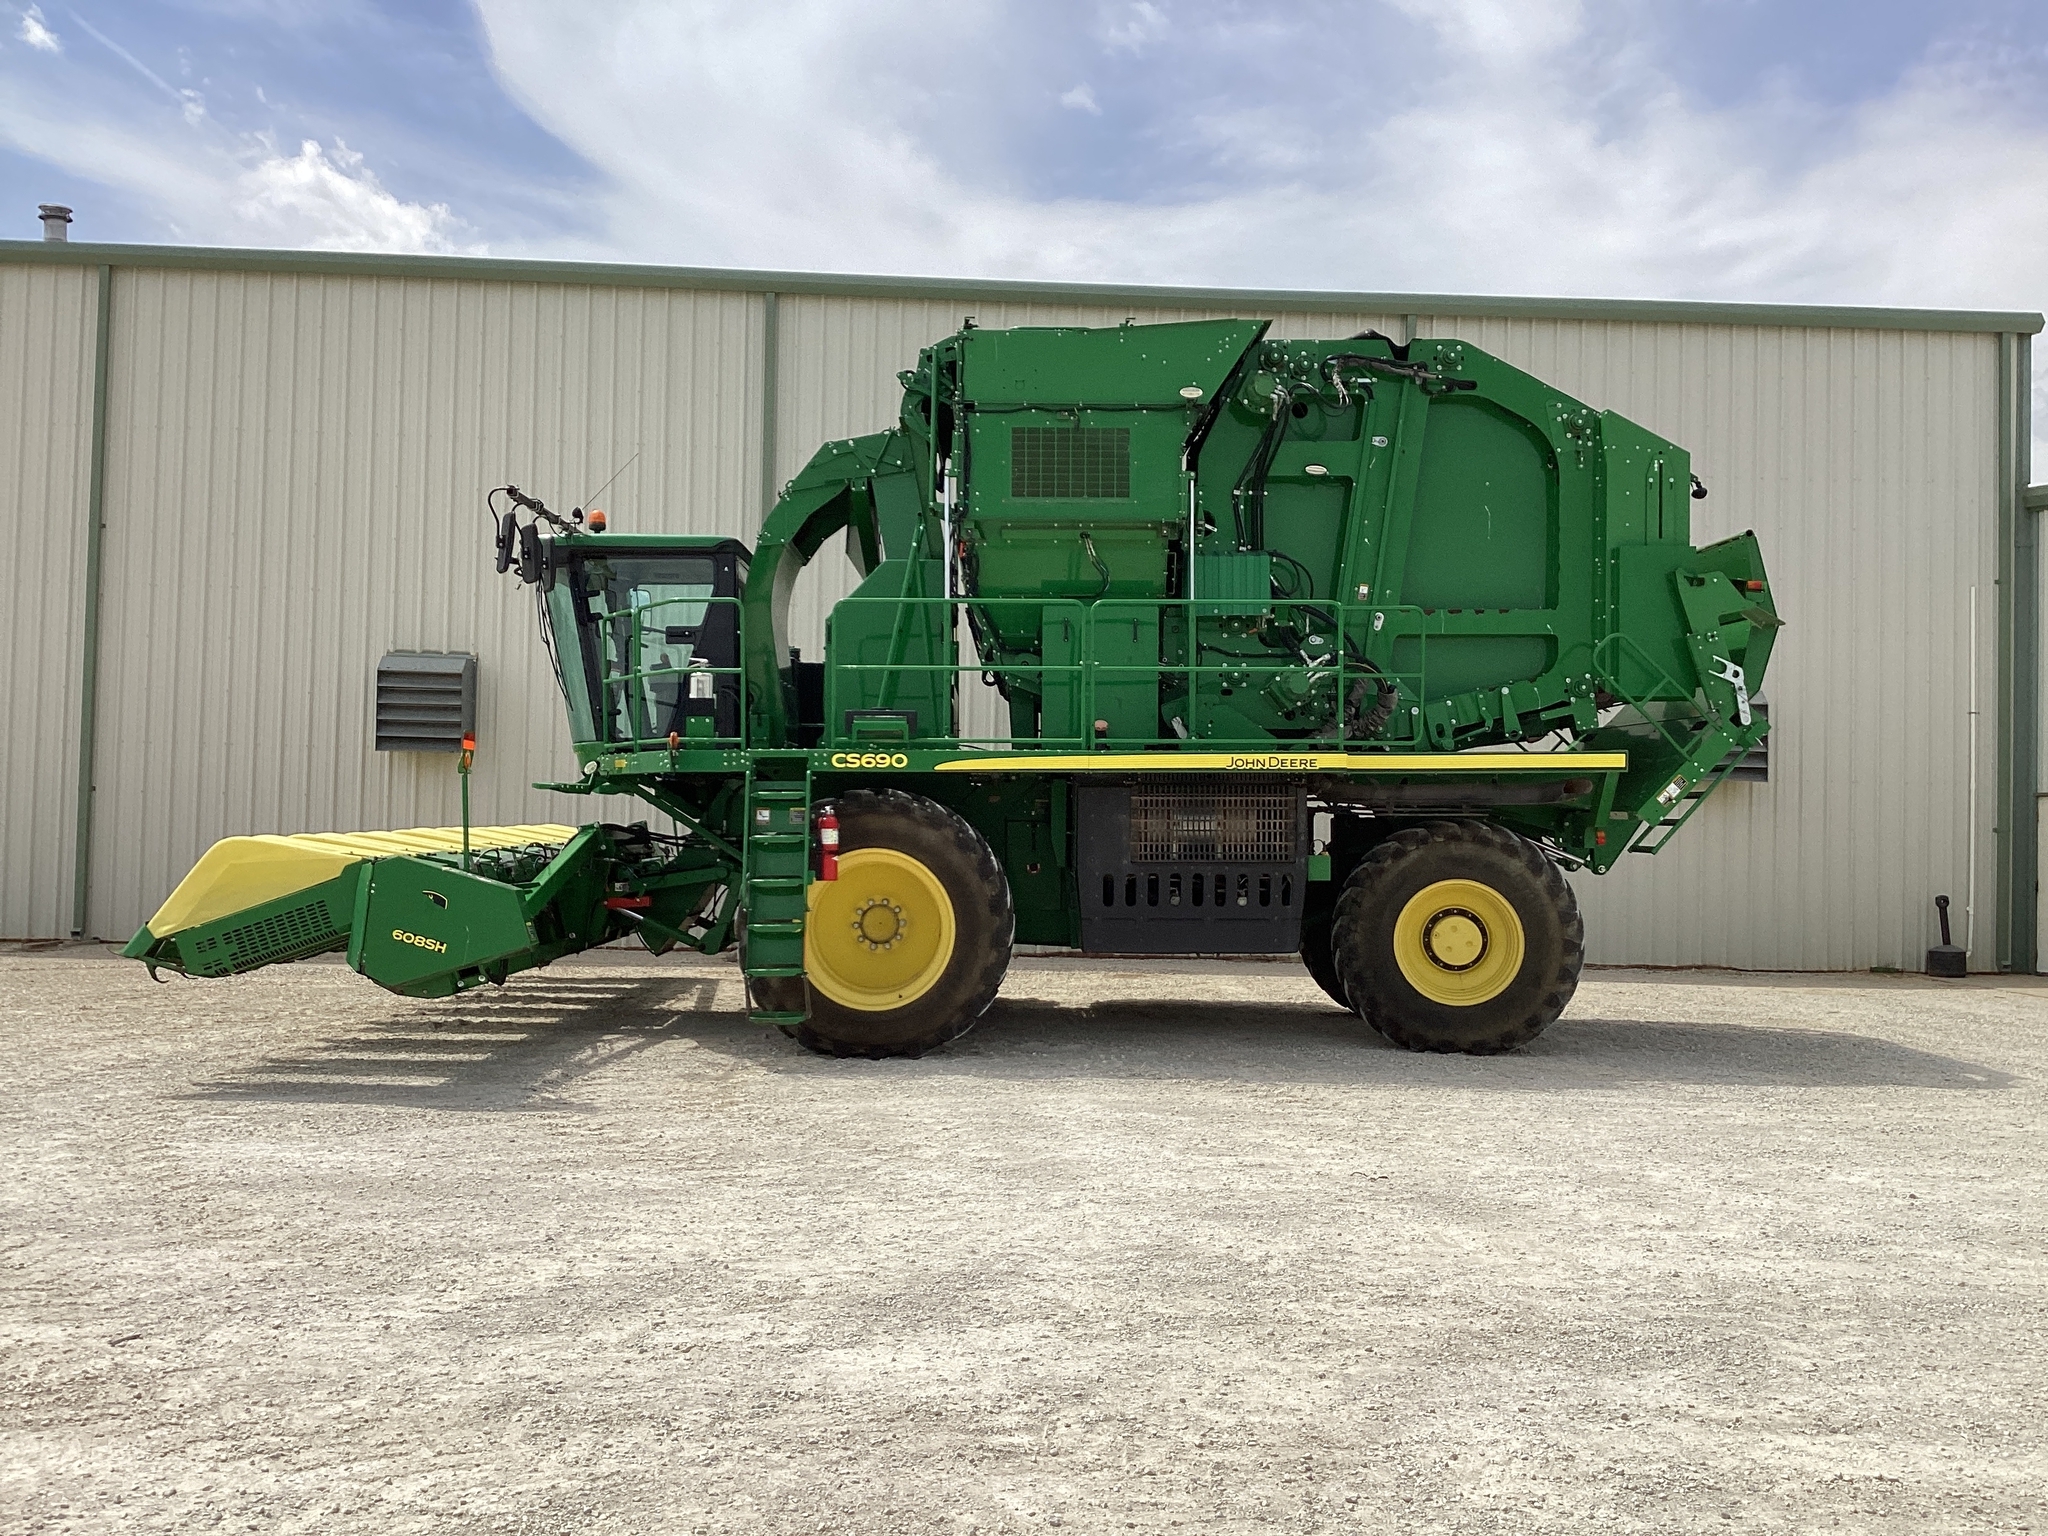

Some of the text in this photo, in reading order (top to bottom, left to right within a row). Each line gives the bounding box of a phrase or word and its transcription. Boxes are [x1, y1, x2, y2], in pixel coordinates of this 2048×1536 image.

[831, 753, 908, 768] CS690
[1226, 756, 1318, 768] JOHN DEERE
[392, 929, 447, 954] 608SH
